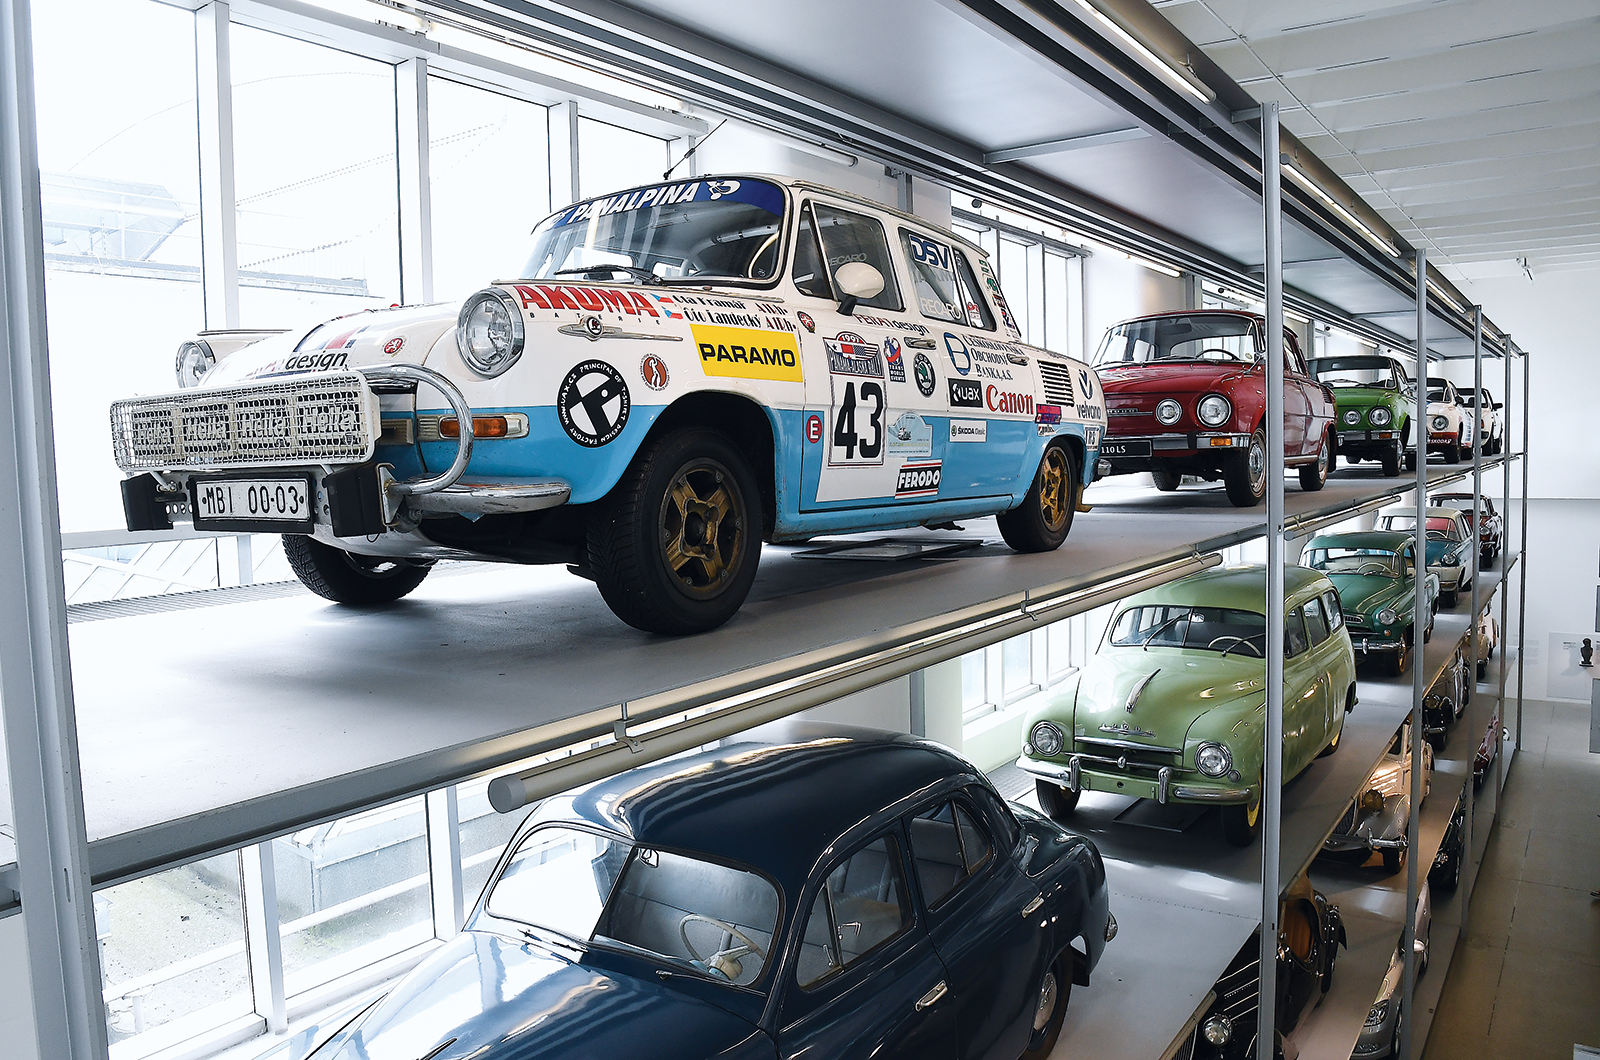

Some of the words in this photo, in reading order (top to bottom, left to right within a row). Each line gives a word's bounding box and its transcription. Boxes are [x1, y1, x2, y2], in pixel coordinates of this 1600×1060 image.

[567, 182, 700, 225] PANALPINA
[910, 237, 948, 269] DSV
[513, 285, 660, 318] AKUMA
[920, 297, 962, 320] RECARO
[699, 343, 796, 367] PARAMO
[986, 384, 1034, 415] Canon
[810, 420, 819, 439] E
[834, 381, 884, 460] 43
[958, 425, 974, 435] ŠKODA
[569, 427, 598, 445] FACTORY
[1101, 446, 1115, 454] 110
[1116, 445, 1126, 454] LS
[897, 470, 940, 489] FERODO
[248, 485, 299, 514] 00-03
